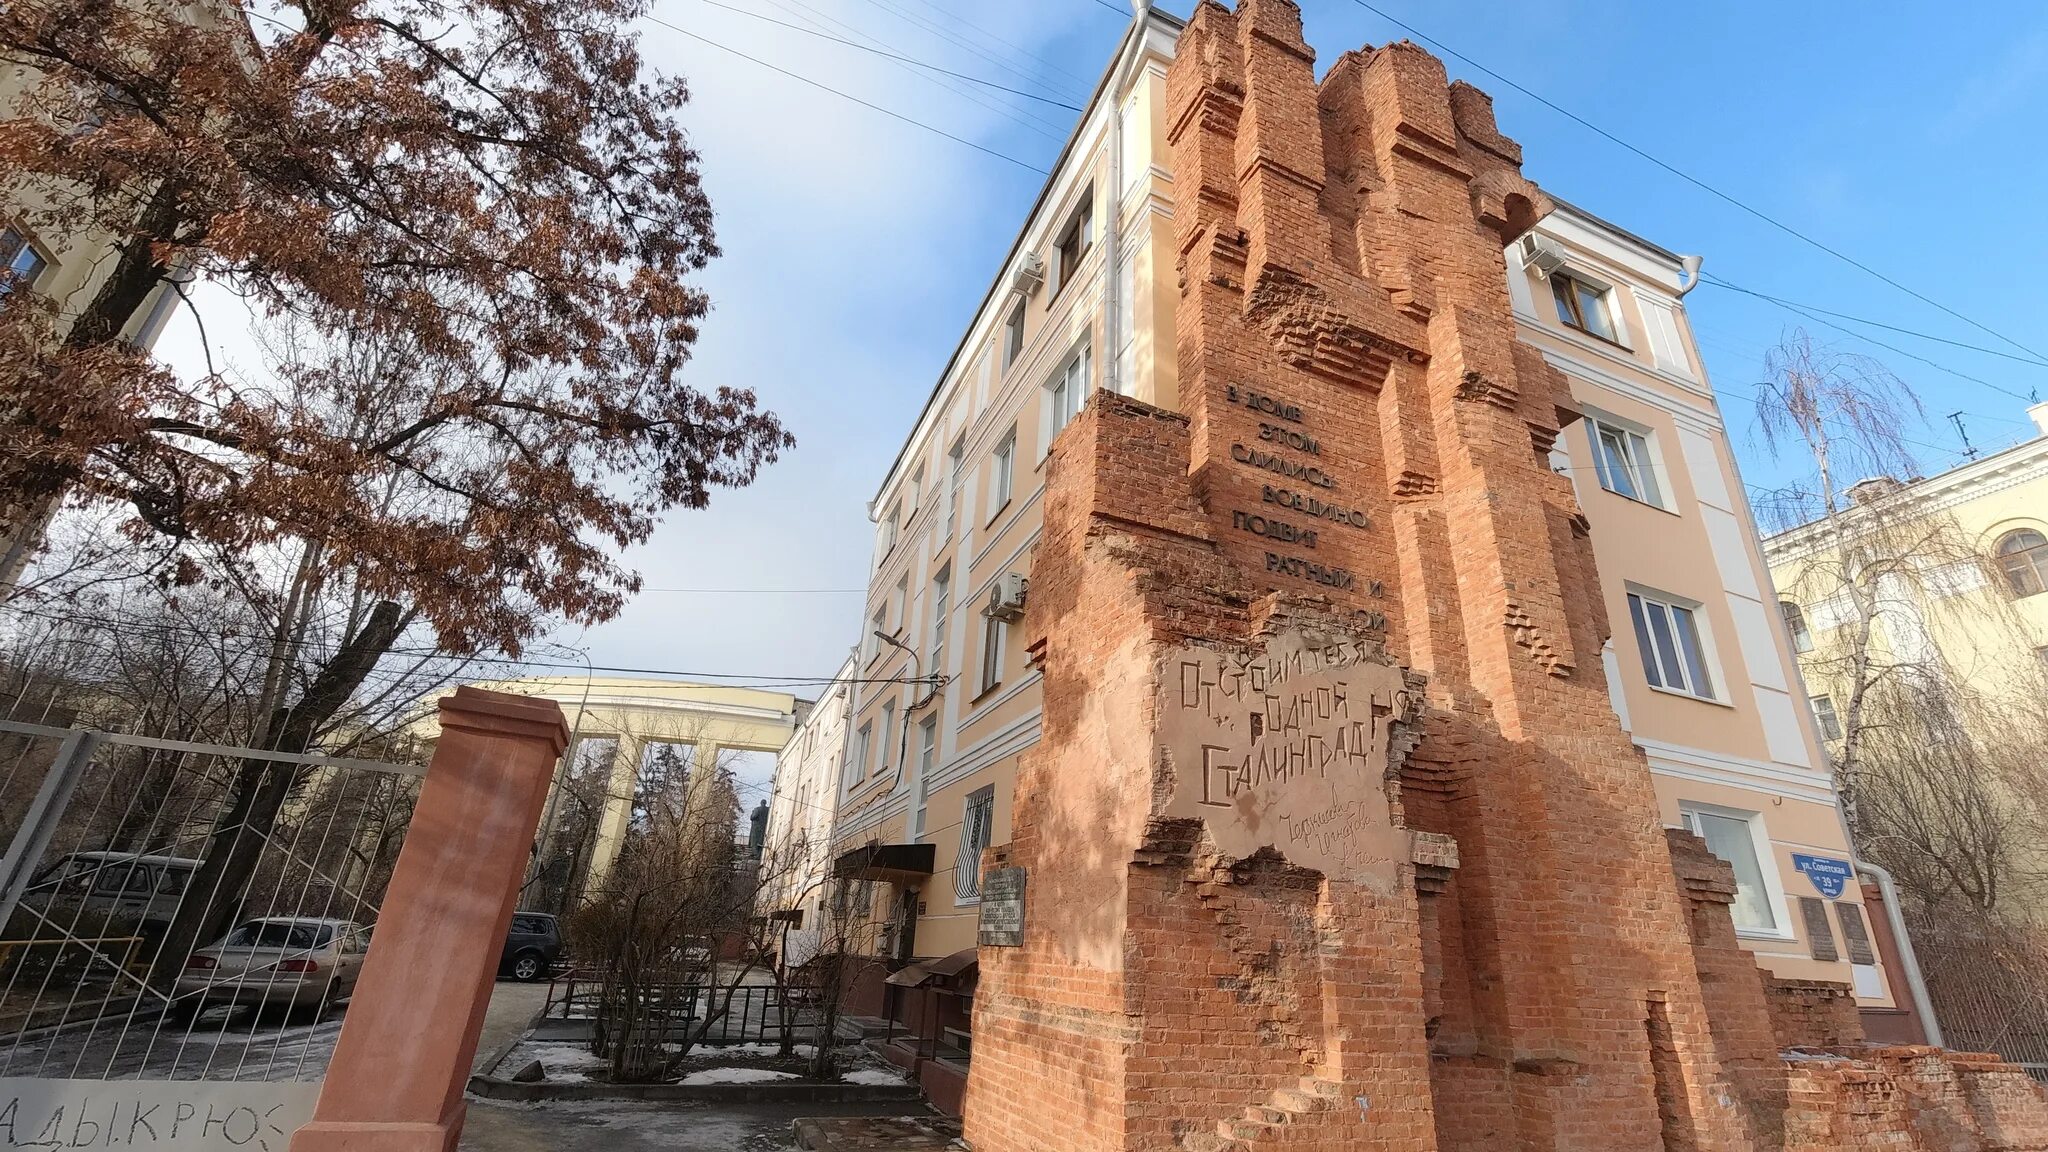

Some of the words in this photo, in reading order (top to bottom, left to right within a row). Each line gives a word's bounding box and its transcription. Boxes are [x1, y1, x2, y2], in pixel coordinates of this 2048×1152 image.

[1245, 391, 1304, 424] ДОМЕ
[1258, 422, 1320, 456] ЭТОМ
[1230, 443, 1334, 488] СЛИЛИСЬ
[1262, 483, 1369, 529] ВОЕДИНО
[1232, 509, 1319, 549] ПОДВИГ
[1265, 550, 1356, 592] РАТНЫЙ
[1367, 579, 1384, 598] И
[1812, 861, 1846, 875] Советская
[1821, 876, 1833, 888] 39
